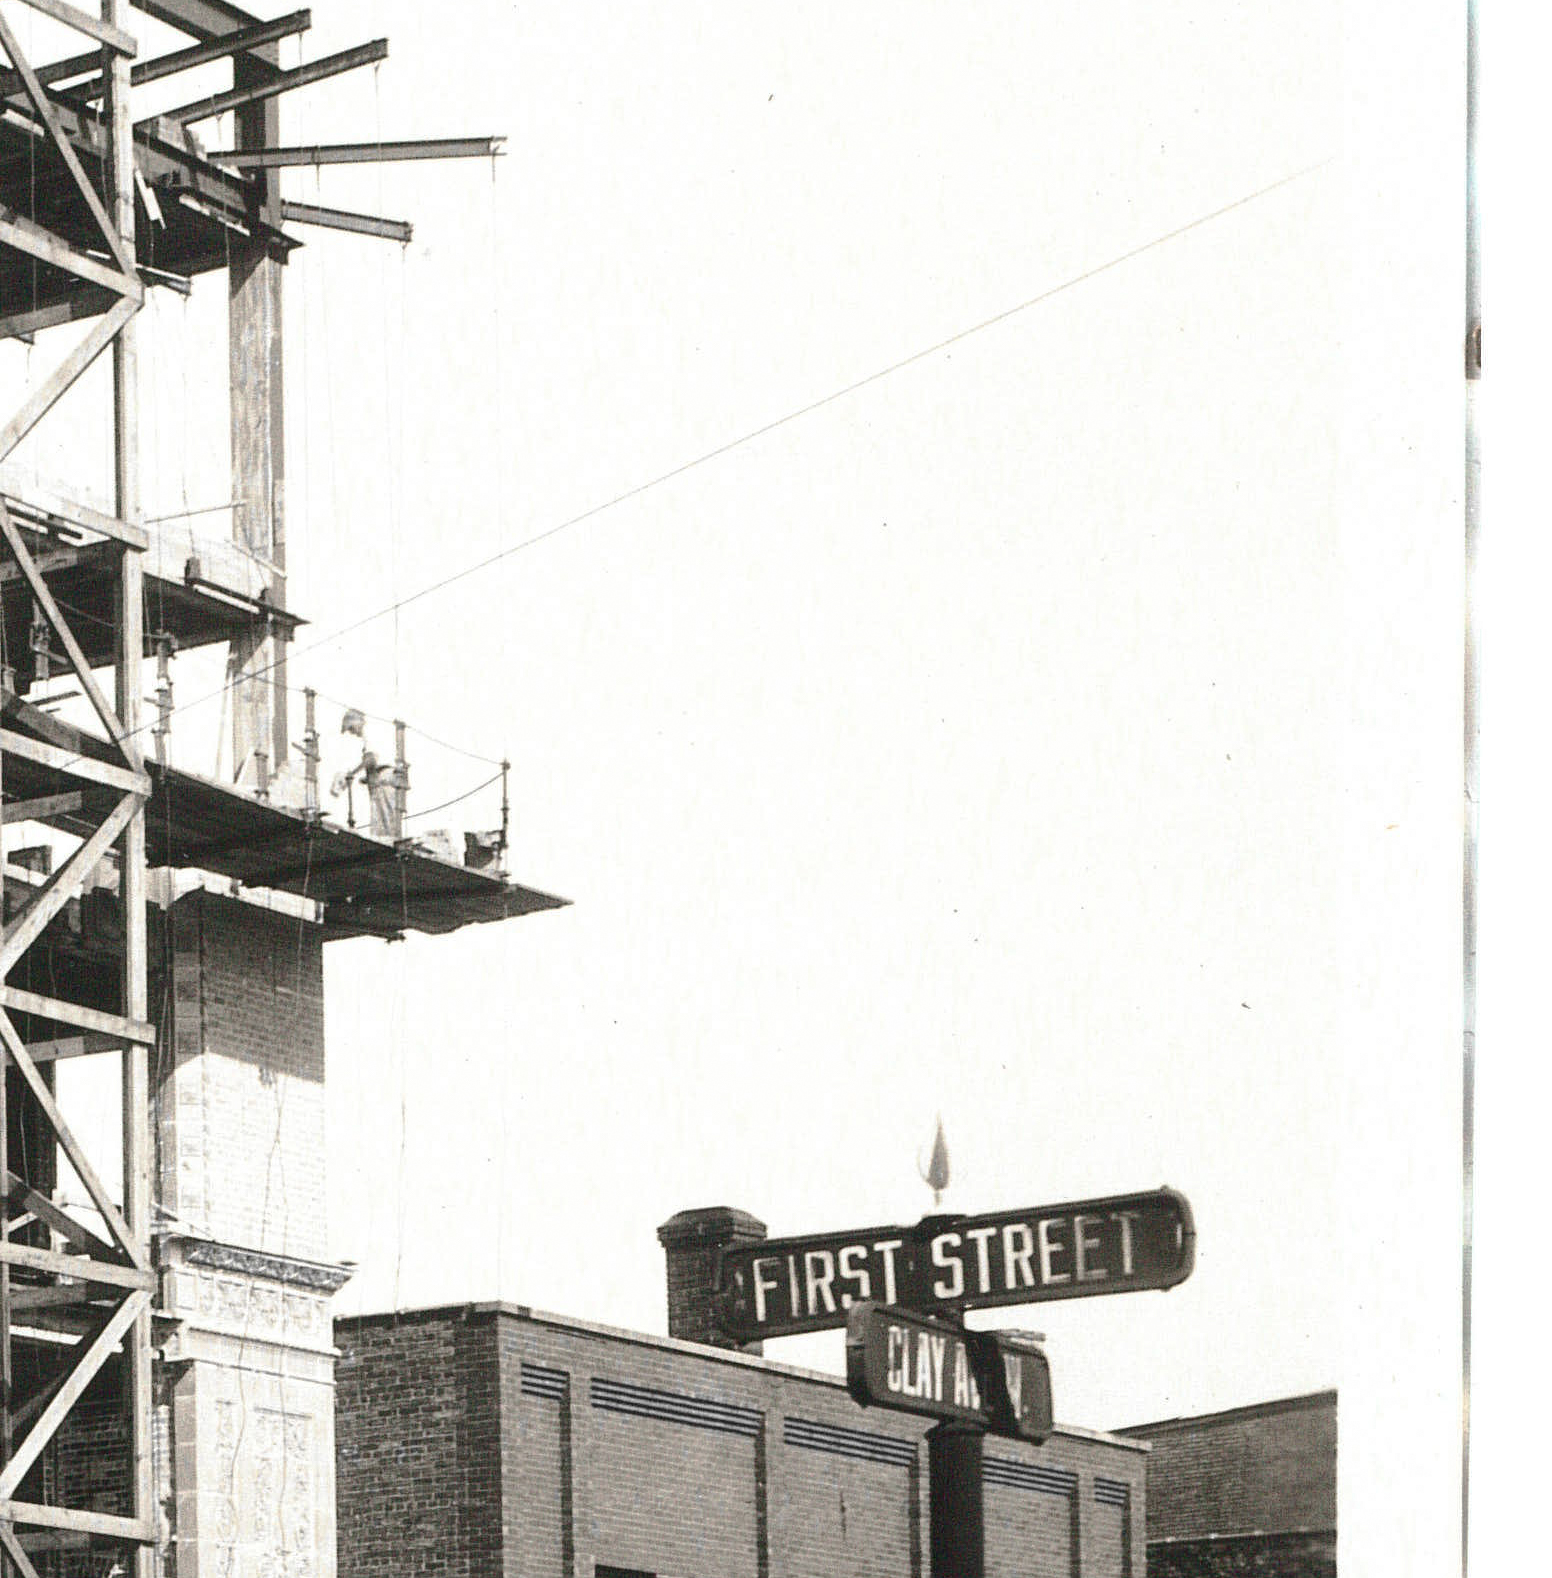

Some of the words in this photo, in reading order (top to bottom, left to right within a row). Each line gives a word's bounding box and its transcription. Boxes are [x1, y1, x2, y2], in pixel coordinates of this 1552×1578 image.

[752, 1239, 903, 1321] FIRST
[931, 1212, 1140, 1300] STREET
[888, 1325, 946, 1401] CLAY
